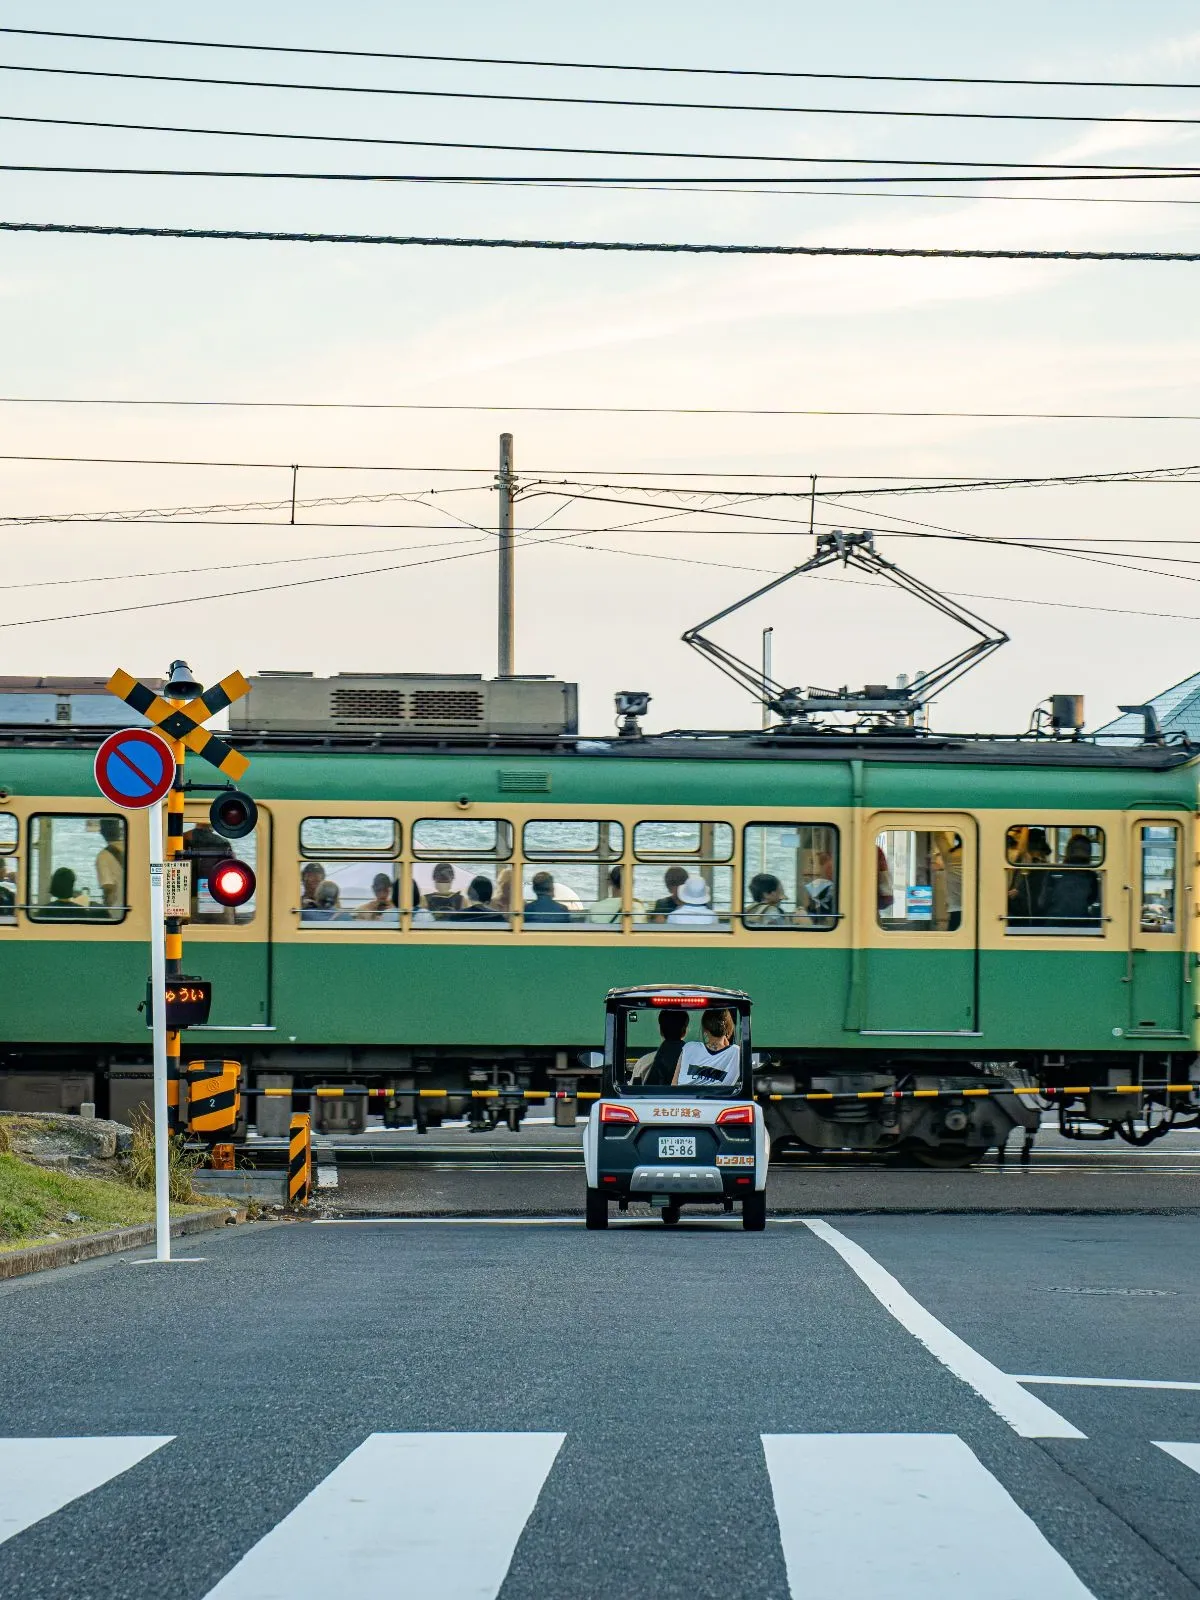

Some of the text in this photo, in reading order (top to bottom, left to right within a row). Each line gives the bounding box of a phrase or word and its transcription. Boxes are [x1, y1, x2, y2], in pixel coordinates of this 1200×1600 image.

[165, 987, 204, 1002] ゅうい
[209, 1098, 216, 1108] 2
[716, 1156, 754, 1165] レンタル中
